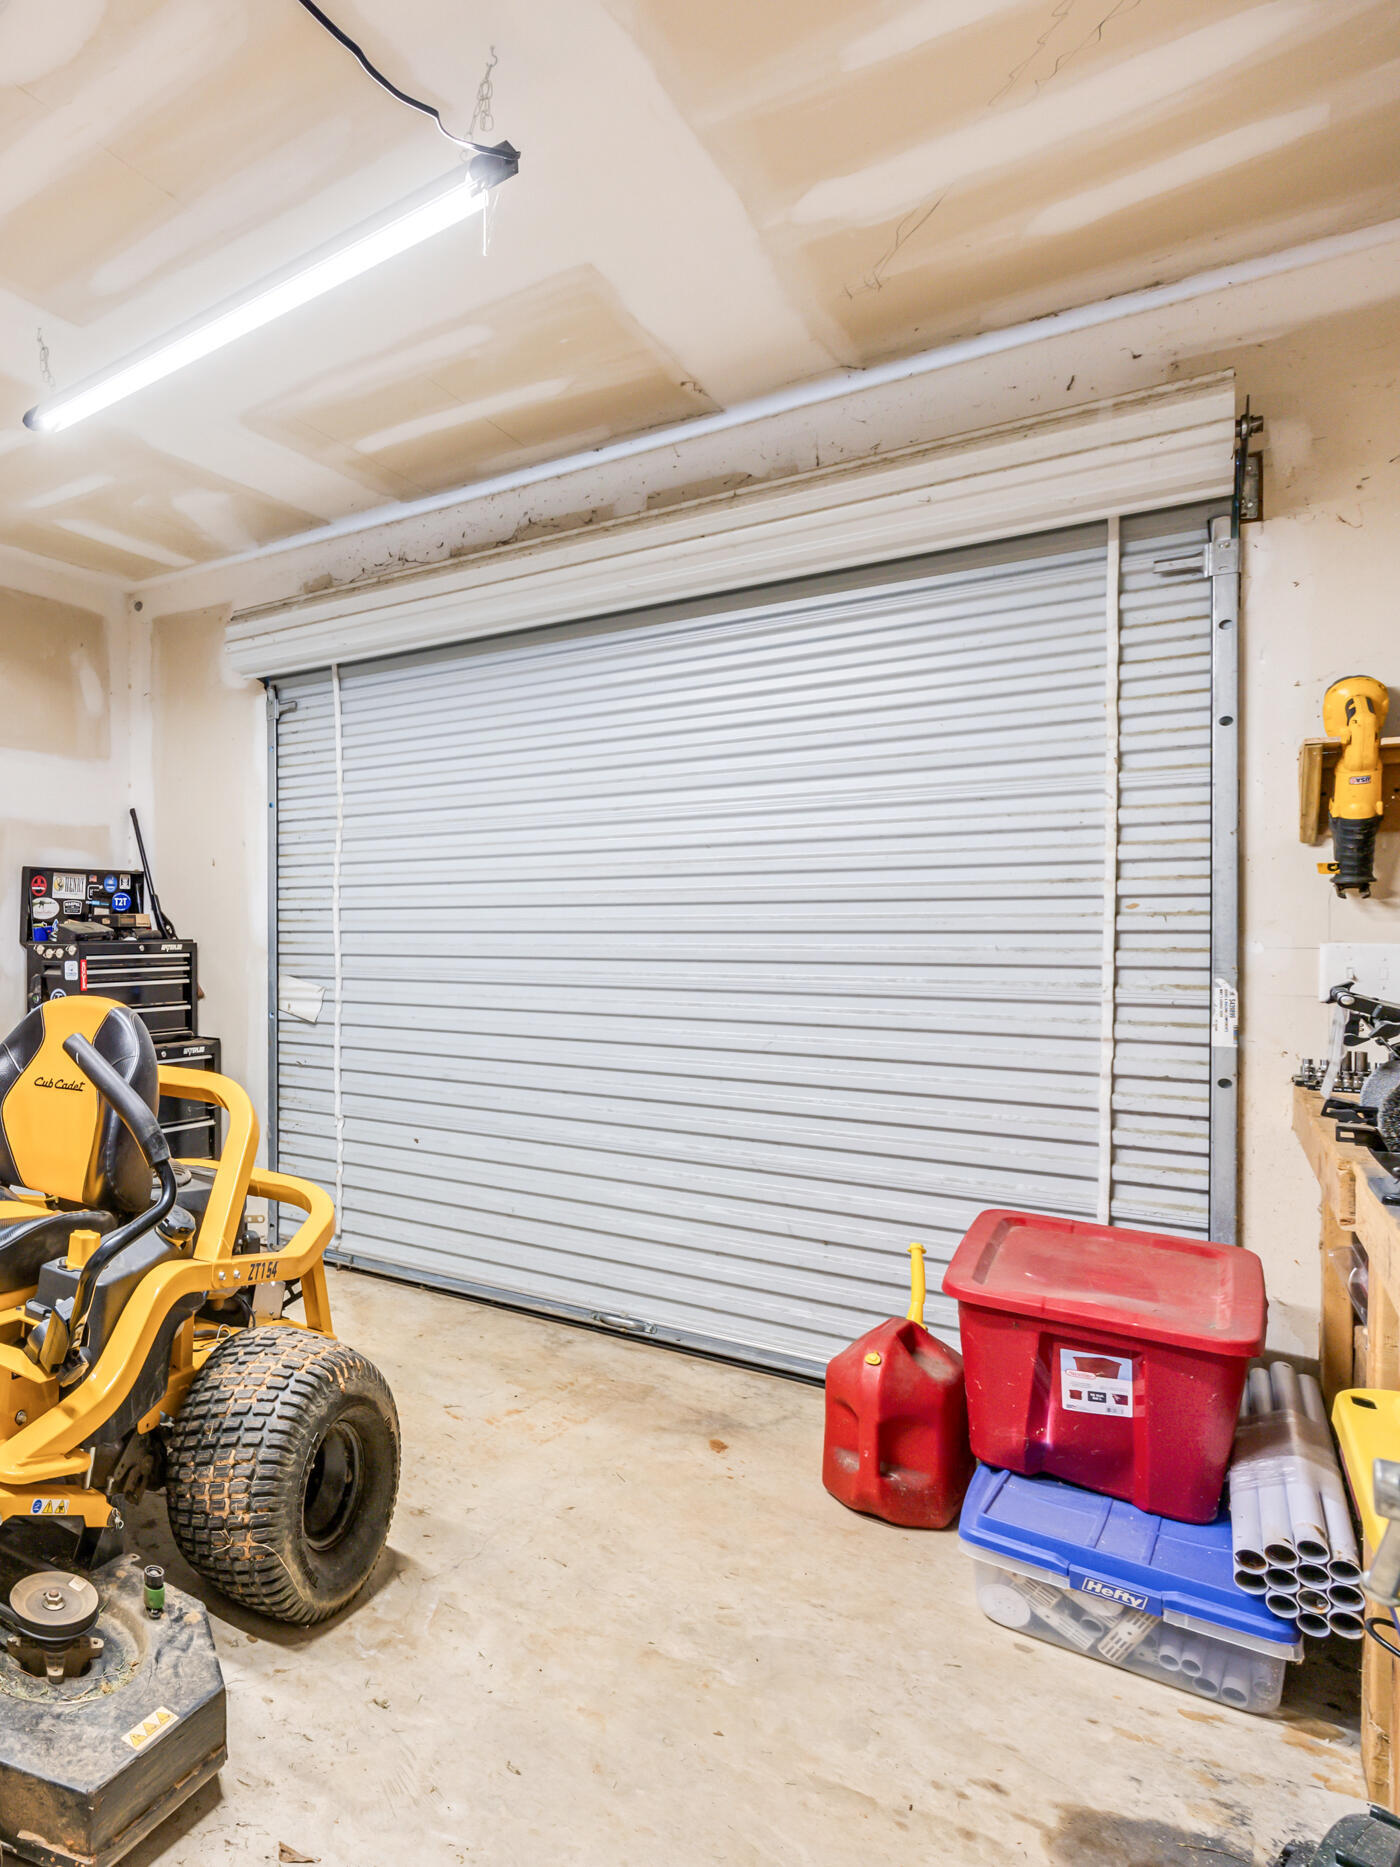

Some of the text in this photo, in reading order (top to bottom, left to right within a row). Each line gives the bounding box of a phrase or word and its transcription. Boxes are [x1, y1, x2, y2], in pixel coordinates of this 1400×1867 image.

[114, 897, 127, 907] T2T
[34, 1076, 86, 1092] Cub Cadet
[248, 1260, 280, 1281] ZT1 54
[1086, 1581, 1143, 1608] Hefty
